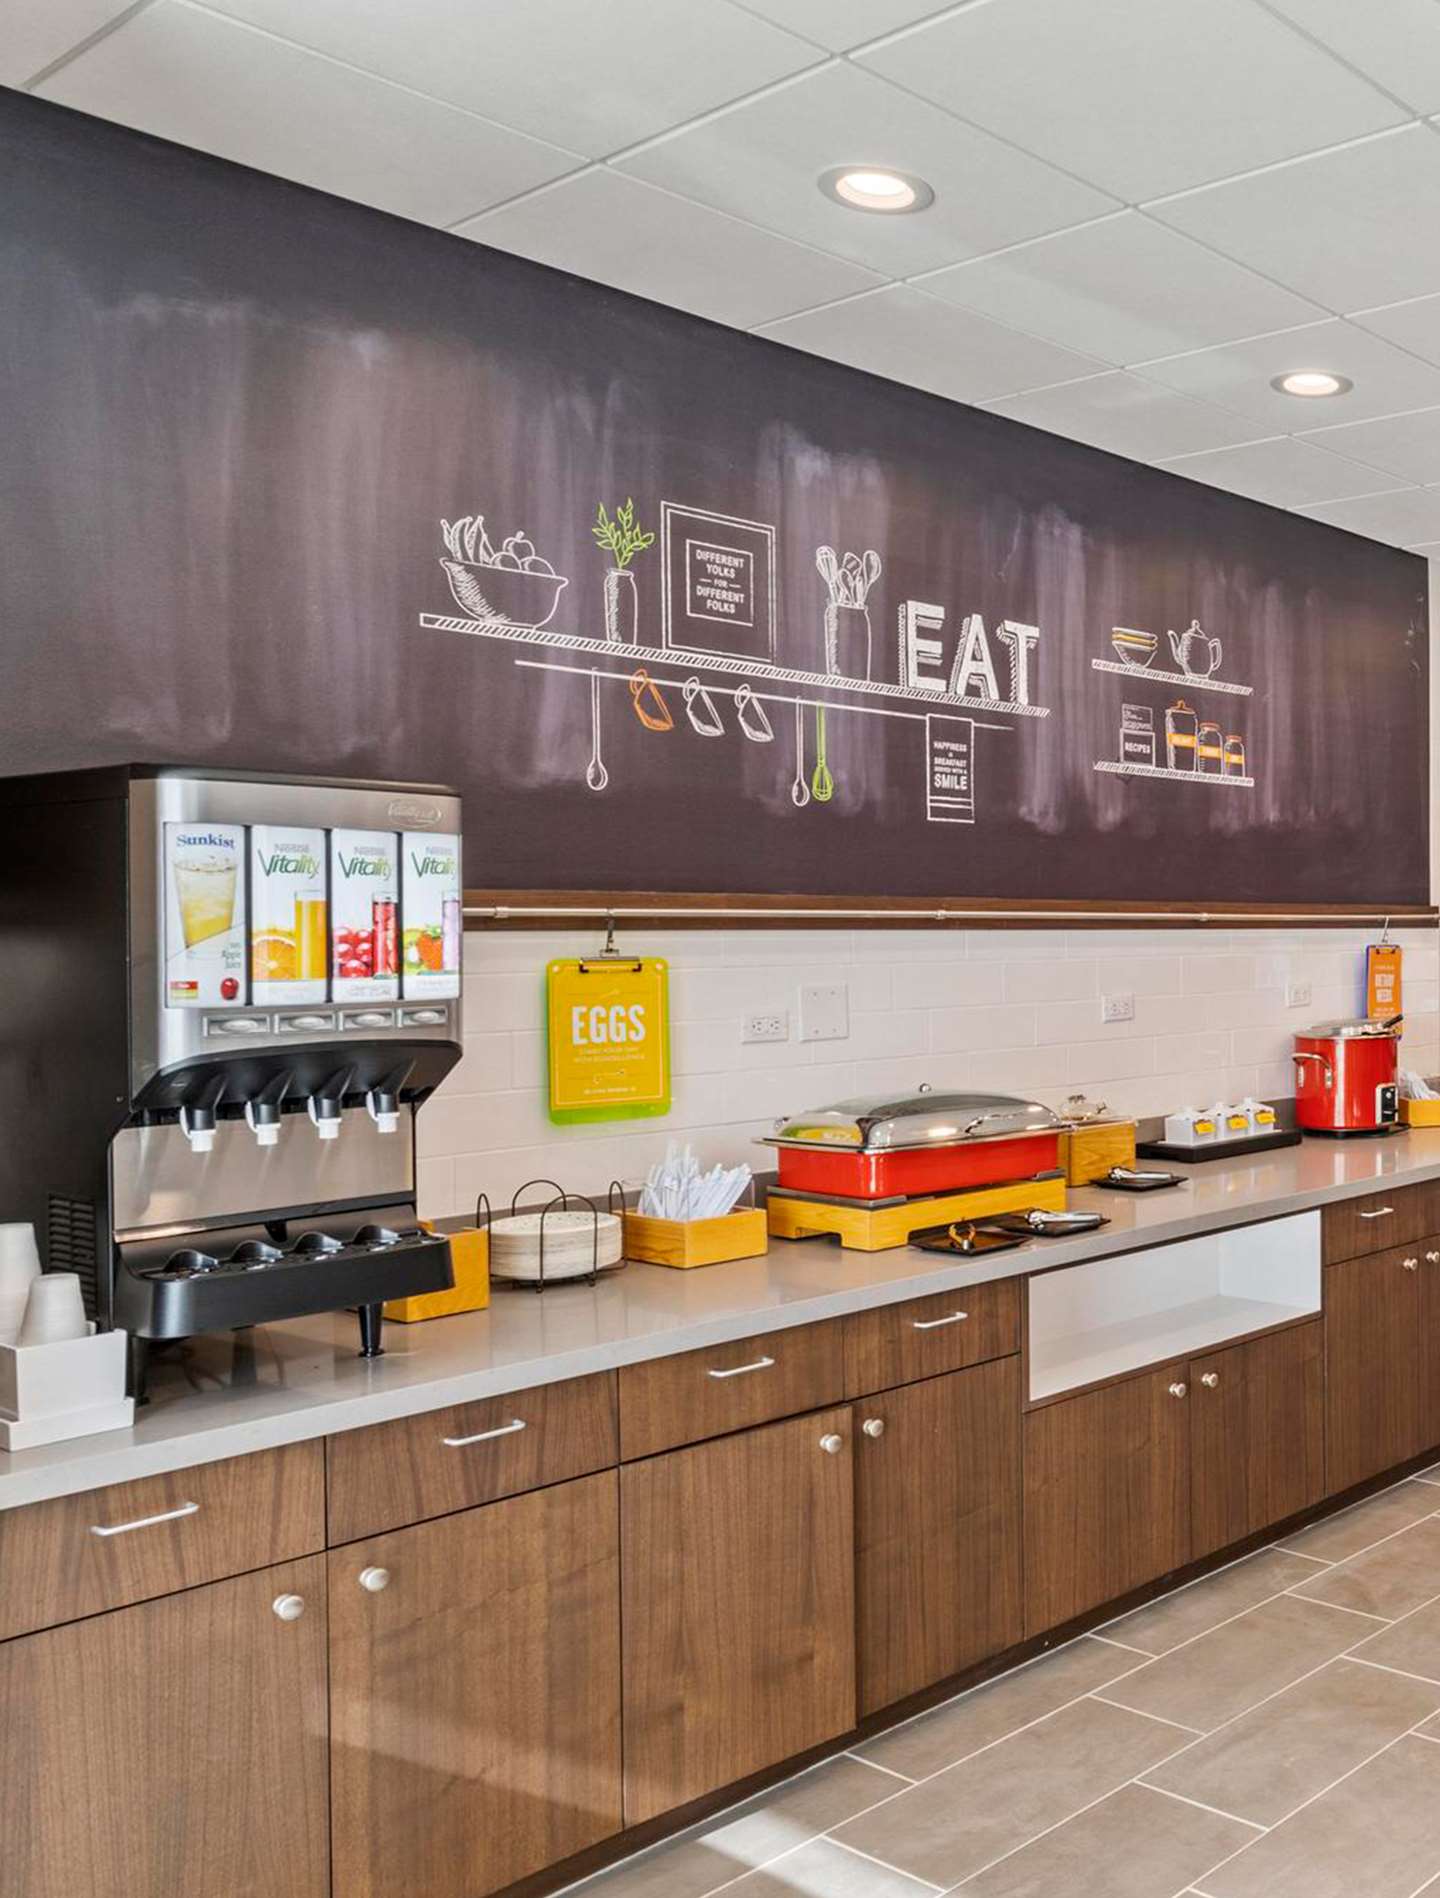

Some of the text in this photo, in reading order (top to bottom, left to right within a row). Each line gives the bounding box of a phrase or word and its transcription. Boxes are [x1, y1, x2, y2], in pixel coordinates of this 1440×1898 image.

[696, 549, 744, 568] DIFFERENT
[706, 563, 735, 578] YOLKS
[696, 585, 744, 603] DIFFERENT
[706, 599, 735, 613] FOLKS
[899, 600, 1040, 705] EAT
[1125, 742, 1151, 753] RECIPES
[934, 774, 967, 790] SMILE
[176, 833, 235, 849] Sunkist
[258, 849, 320, 880] Vitality
[338, 851, 391, 882] Vitality
[572, 1004, 646, 1046] EGGS
